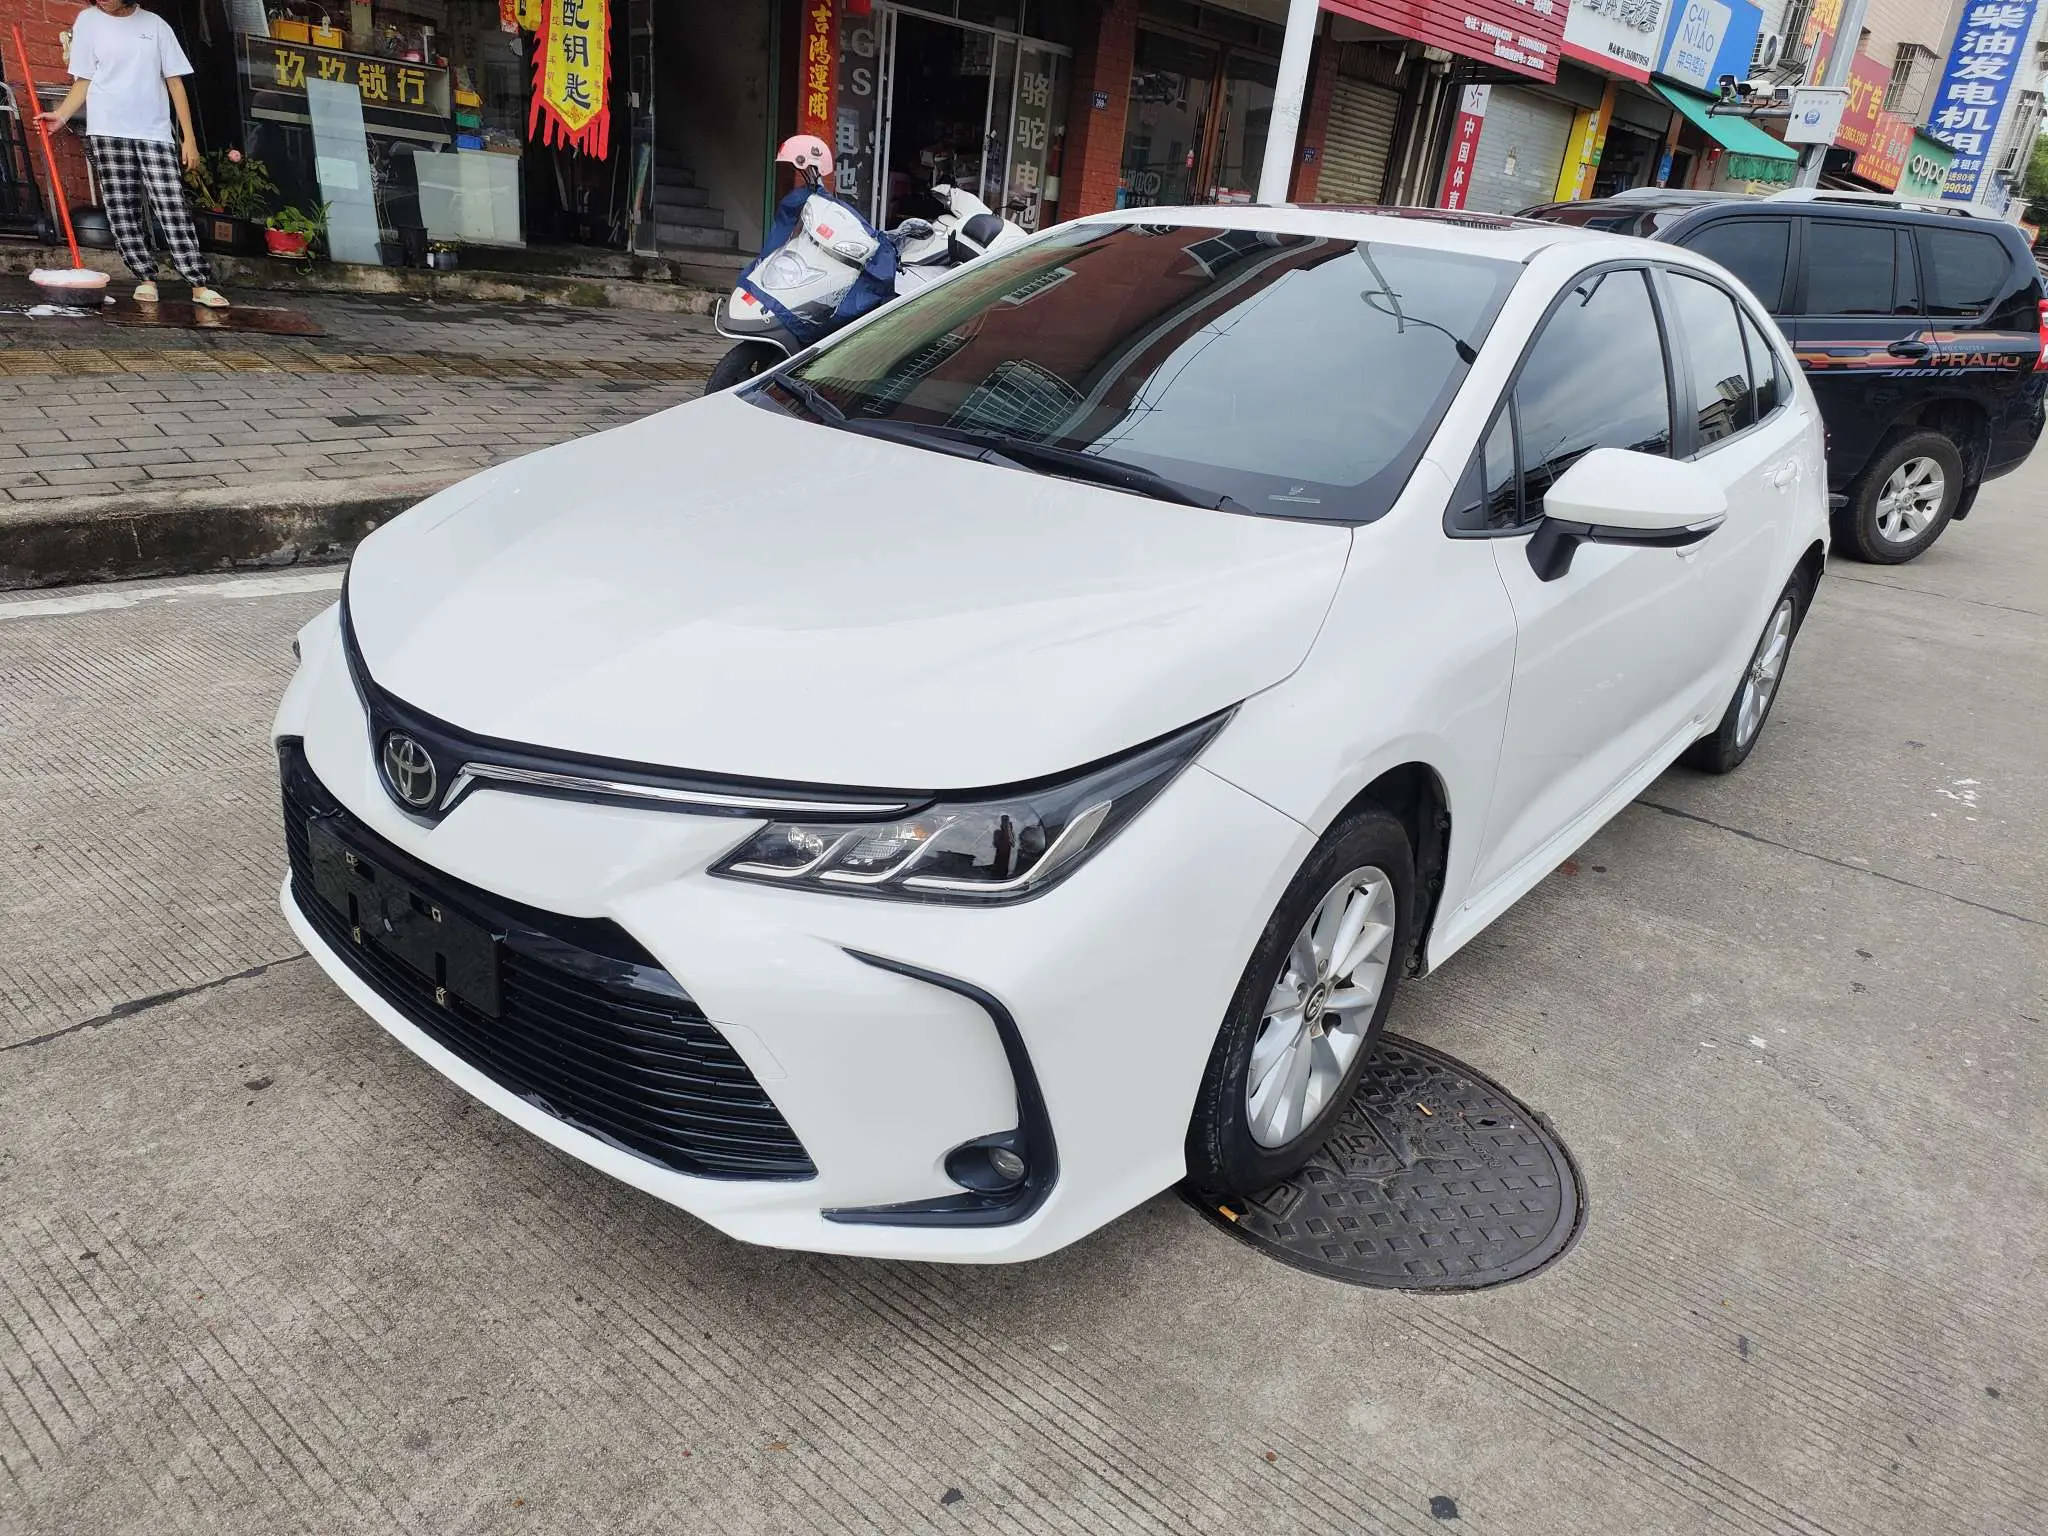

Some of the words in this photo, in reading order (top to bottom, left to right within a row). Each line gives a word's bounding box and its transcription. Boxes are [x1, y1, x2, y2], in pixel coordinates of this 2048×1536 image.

[275, 49, 426, 105] 玖玖锁行
[562, 0, 591, 110] 配钥匙
[1846, 72, 1883, 120] 文广告
[1932, 4, 2028, 156] 柴油发电机组
[1011, 71, 1050, 229] 骆驼电池
[1448, 117, 1475, 210] 中国体育
[1929, 352, 2021, 367] PRADO
